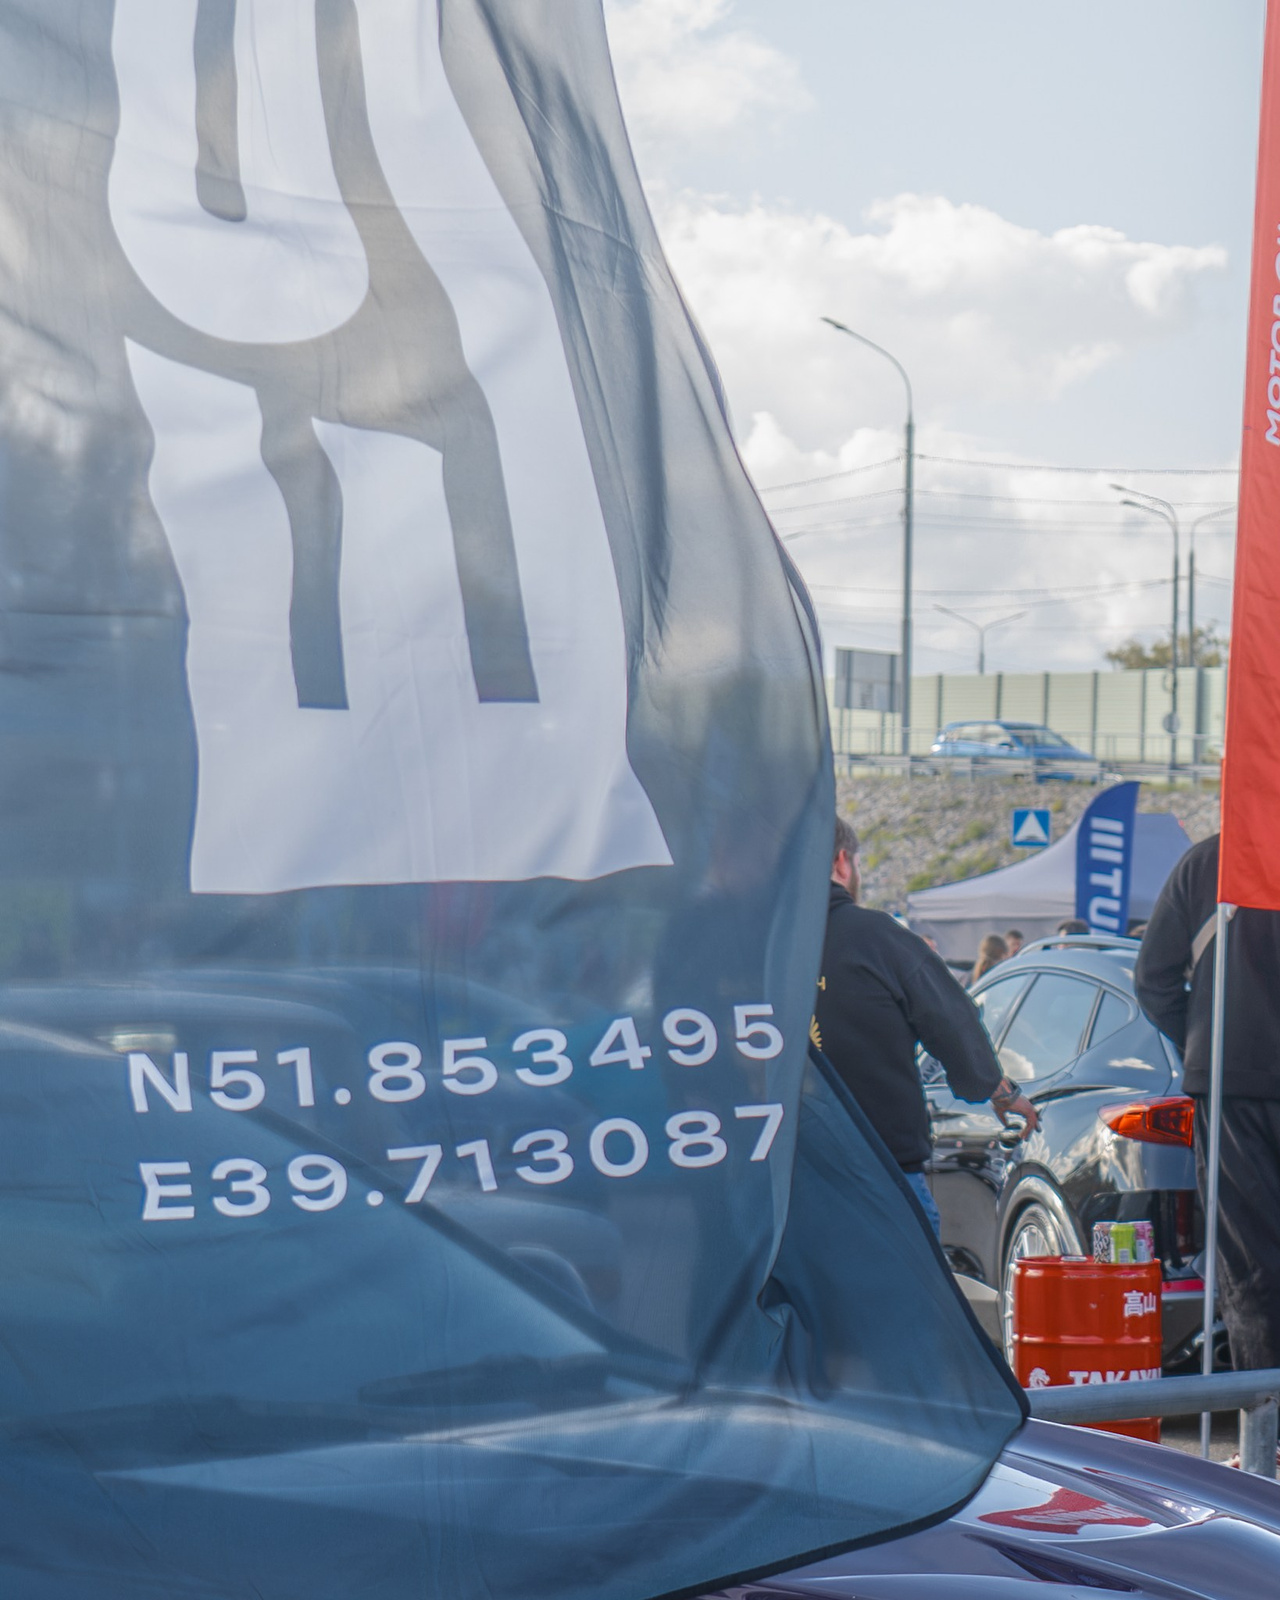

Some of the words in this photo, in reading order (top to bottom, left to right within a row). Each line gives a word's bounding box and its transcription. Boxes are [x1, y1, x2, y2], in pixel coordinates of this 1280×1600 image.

[126, 1002, 785, 1114] N51.853495
[138, 1103, 785, 1221] E39.713087
[1123, 1290, 1156, 1317] 高山
